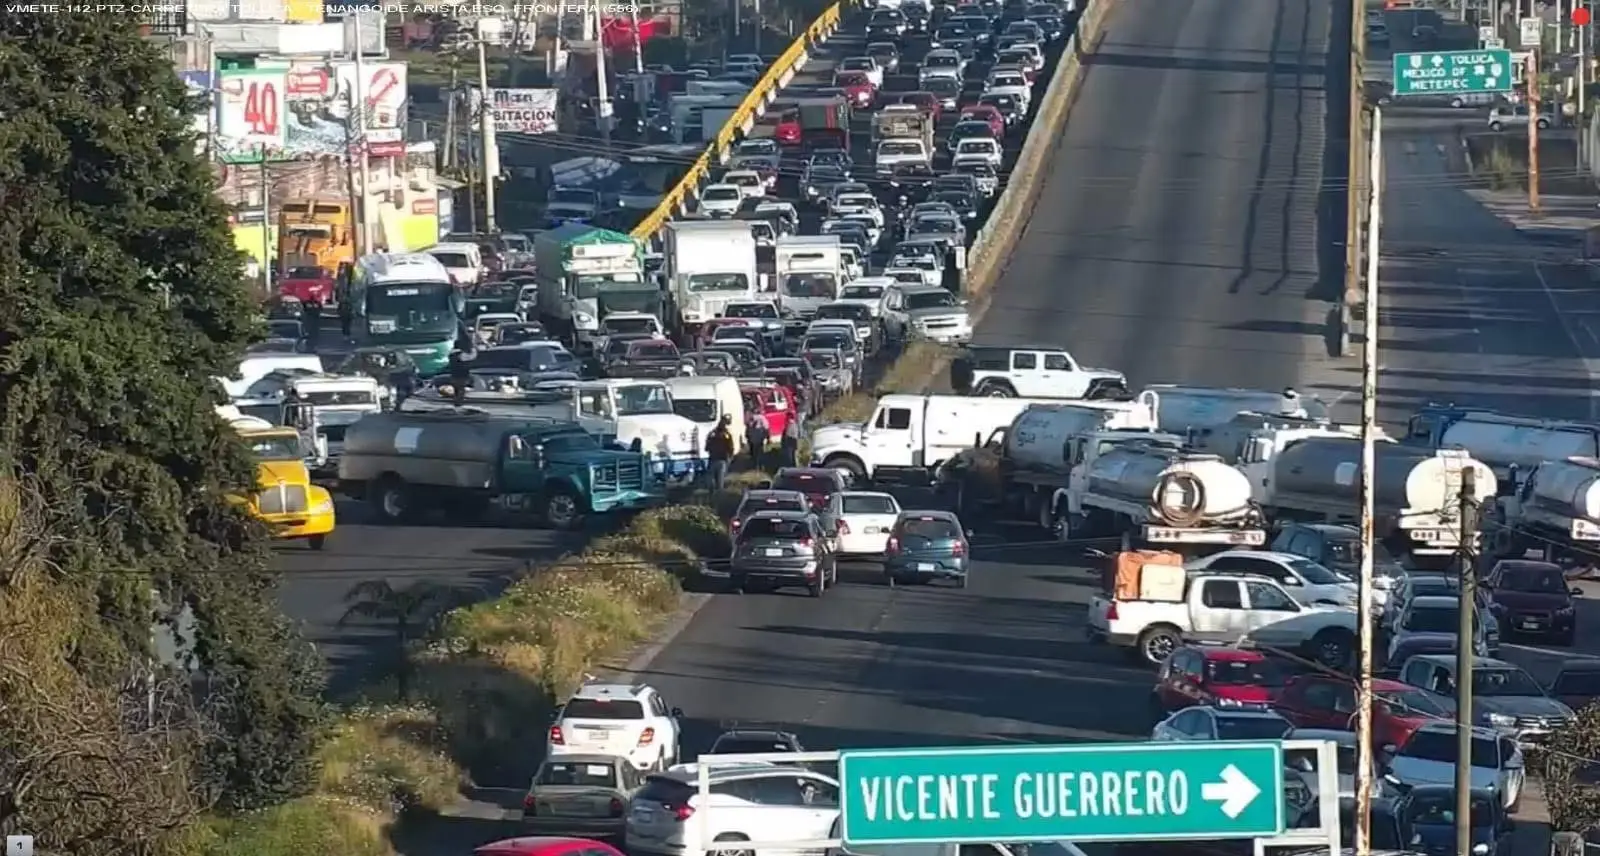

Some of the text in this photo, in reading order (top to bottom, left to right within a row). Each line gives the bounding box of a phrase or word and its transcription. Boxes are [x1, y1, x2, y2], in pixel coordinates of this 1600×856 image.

[1450, 53, 1495, 65] TOLUCA
[1410, 79, 1469, 90] METEPEC
[860, 769, 1189, 823] VICENTE GUERRERO
